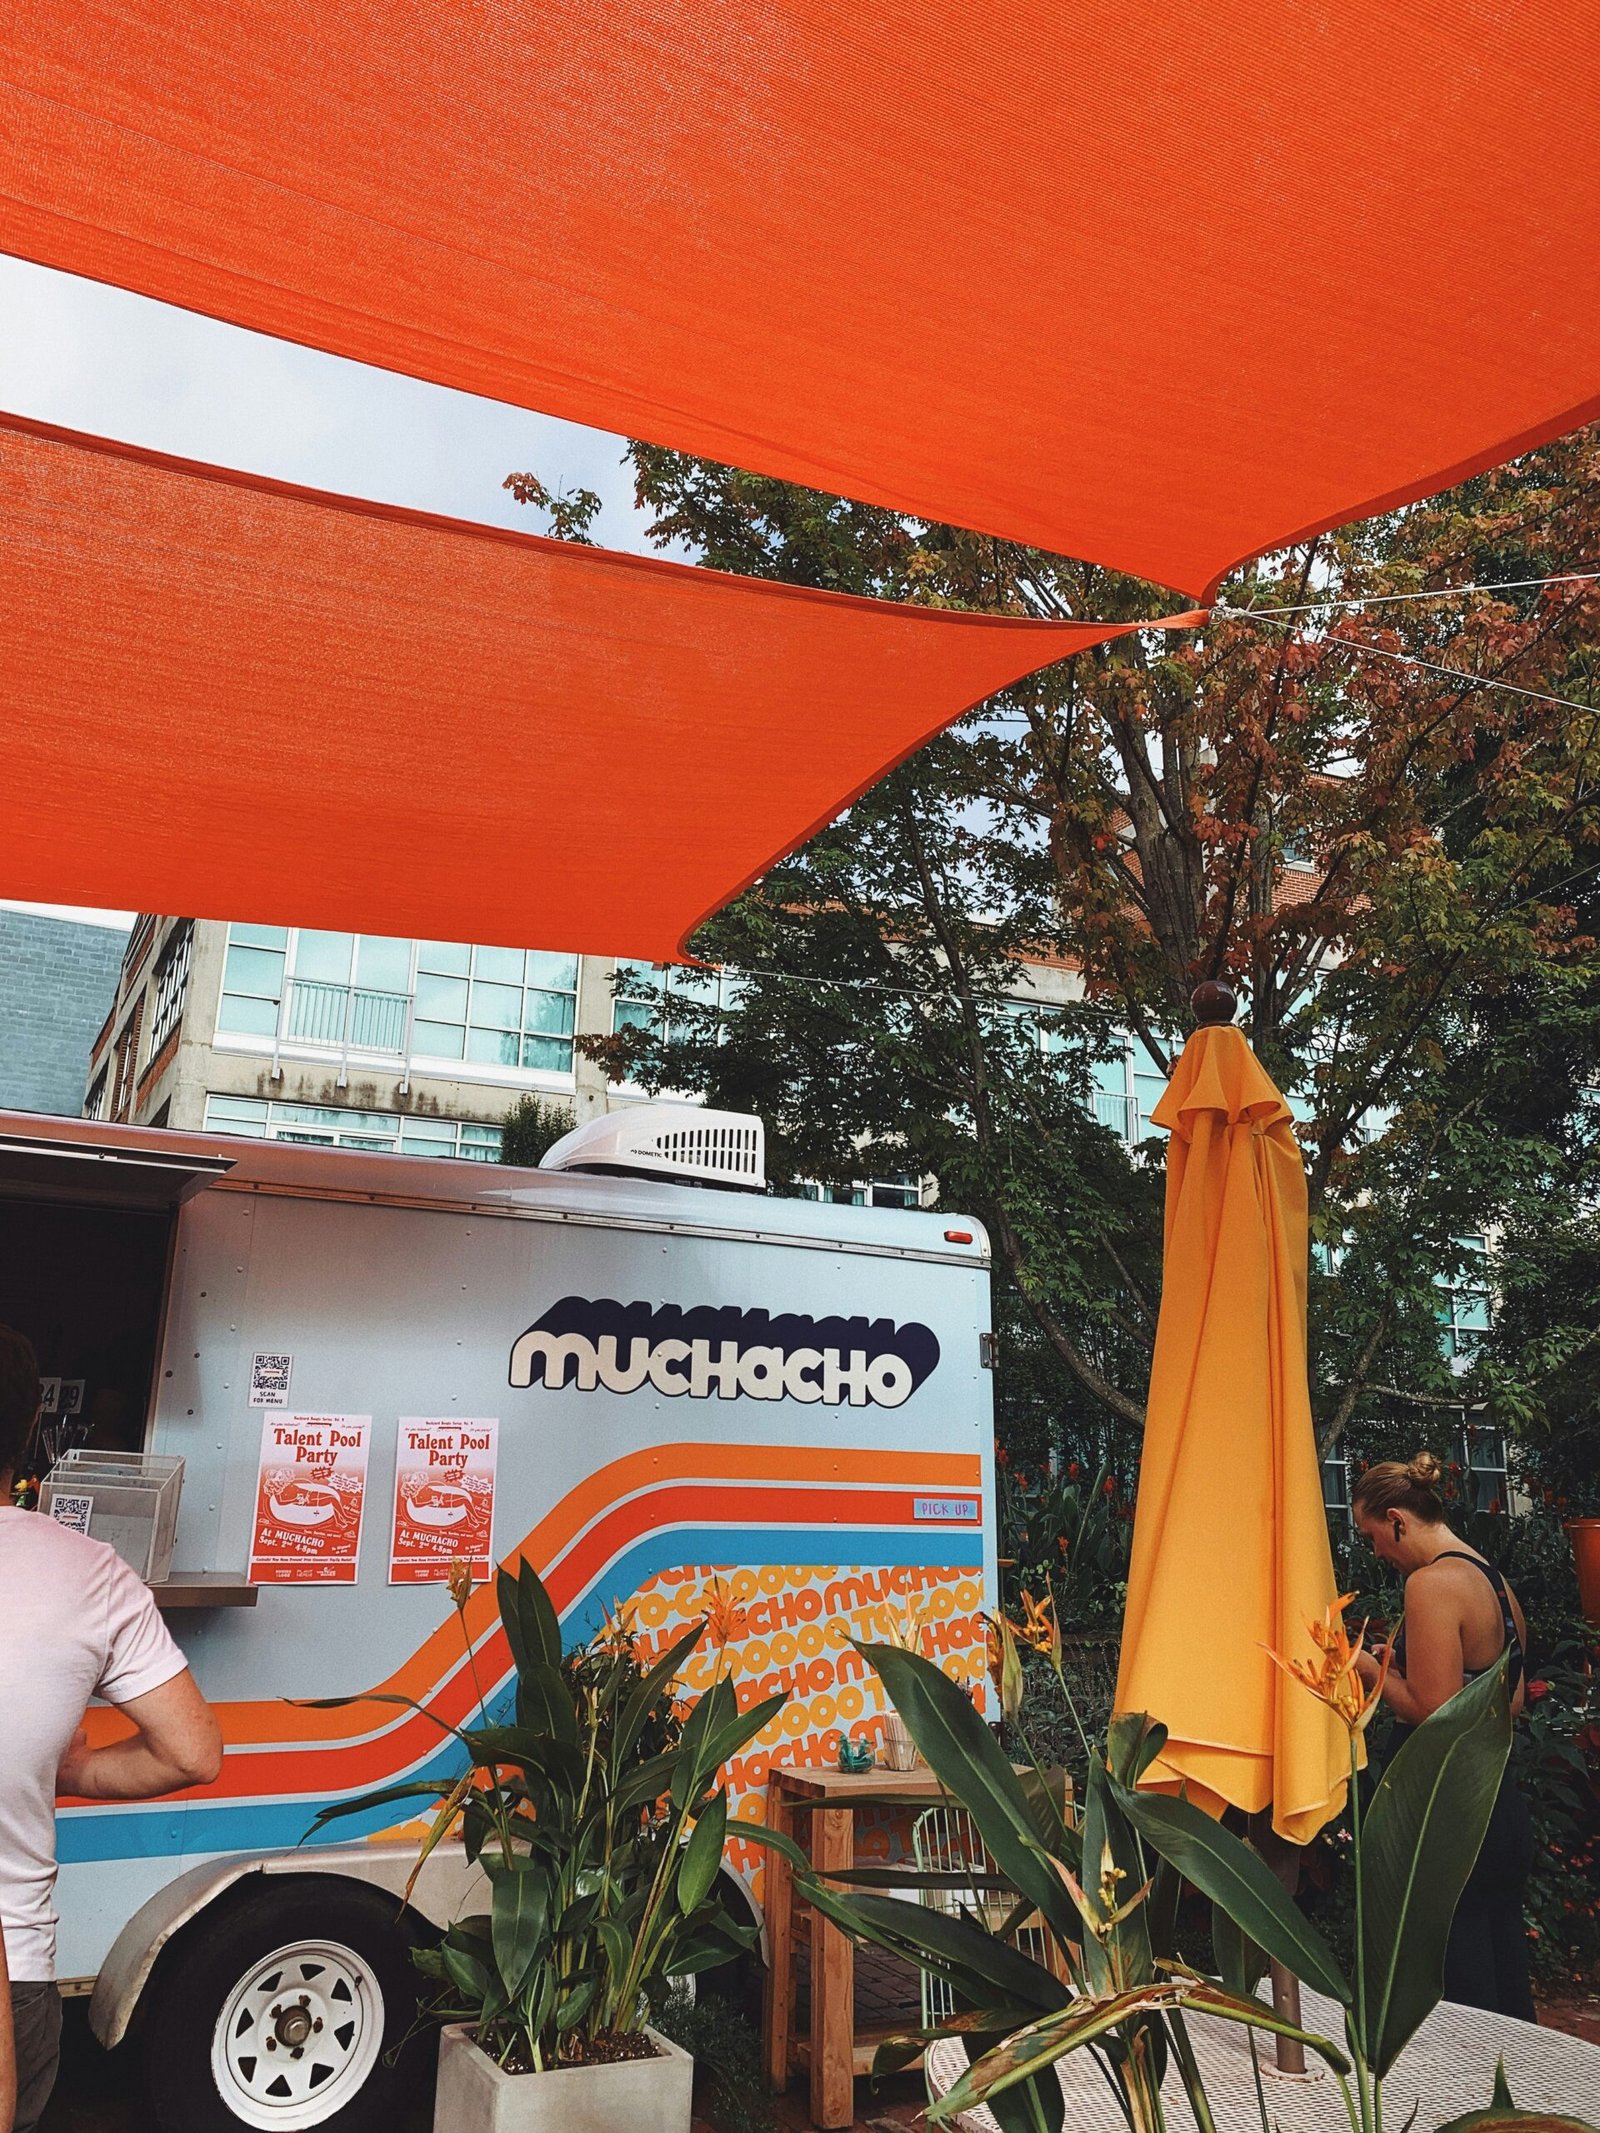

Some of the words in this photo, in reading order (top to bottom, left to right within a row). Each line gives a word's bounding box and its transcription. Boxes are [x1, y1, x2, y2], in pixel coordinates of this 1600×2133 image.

[637, 1149, 663, 1158] DOMETIC
[273, 1428, 323, 1446] Talent
[329, 1430, 362, 1448] Pool
[407, 1433, 454, 1450] Talent
[459, 1433, 490, 1450] Pool
[295, 1446, 338, 1466] Party
[428, 1450, 469, 1468] Party
[921, 1502, 949, 1516] PICK
[954, 1503, 969, 1516] UP
[258, 1536, 278, 1547] Sept.
[294, 1544, 318, 1556] 4-8pm
[261, 1527, 272, 1537] At
[274, 1531, 325, 1548] MUCHACHO
[397, 1537, 416, 1548] Sept.
[431, 1544, 453, 1555] 4-8pm
[400, 1529, 410, 1538] At
[412, 1531, 459, 1548] MUCHACHO
[851, 1579, 984, 1643] TO-GOO
